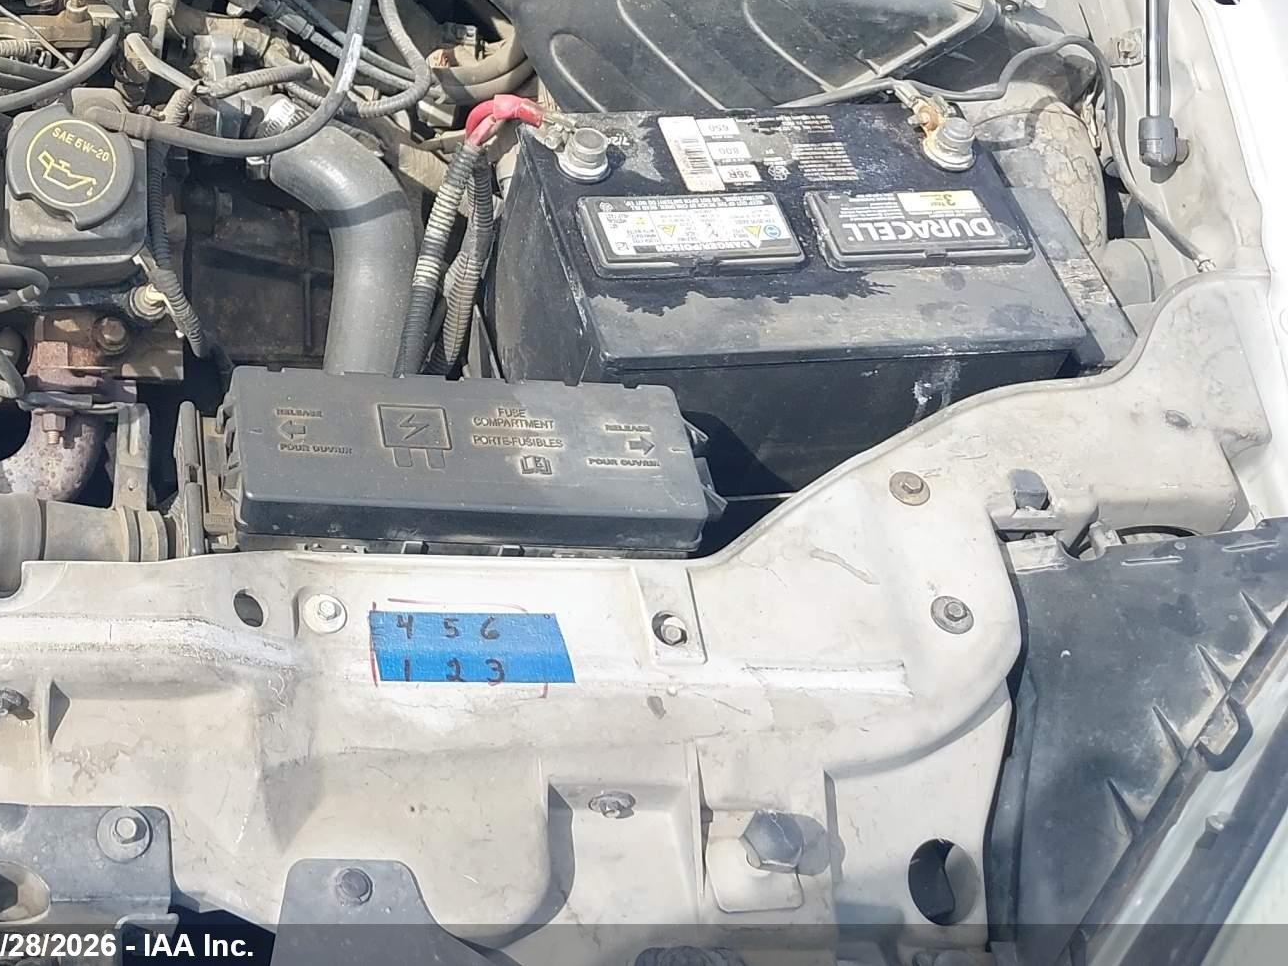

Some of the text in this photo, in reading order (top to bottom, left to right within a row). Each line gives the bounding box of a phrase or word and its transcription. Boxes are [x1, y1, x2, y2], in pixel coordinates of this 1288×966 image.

[52, 127, 110, 162] SAE 5W-20
[941, 193, 956, 207] 3
[841, 217, 997, 242] DURACELL
[276, 408, 323, 418] RELEASE
[497, 407, 527, 418] FUSE
[472, 417, 555, 429] COMPARTMENT
[604, 424, 653, 433] RELEASE
[279, 443, 310, 452] POUR
[473, 435, 564, 449] PORTE-FUSIBLES
[588, 457, 619, 467] POUR
[397, 614, 500, 640] 4 5 6
[403, 657, 505, 684] 1 2 3
